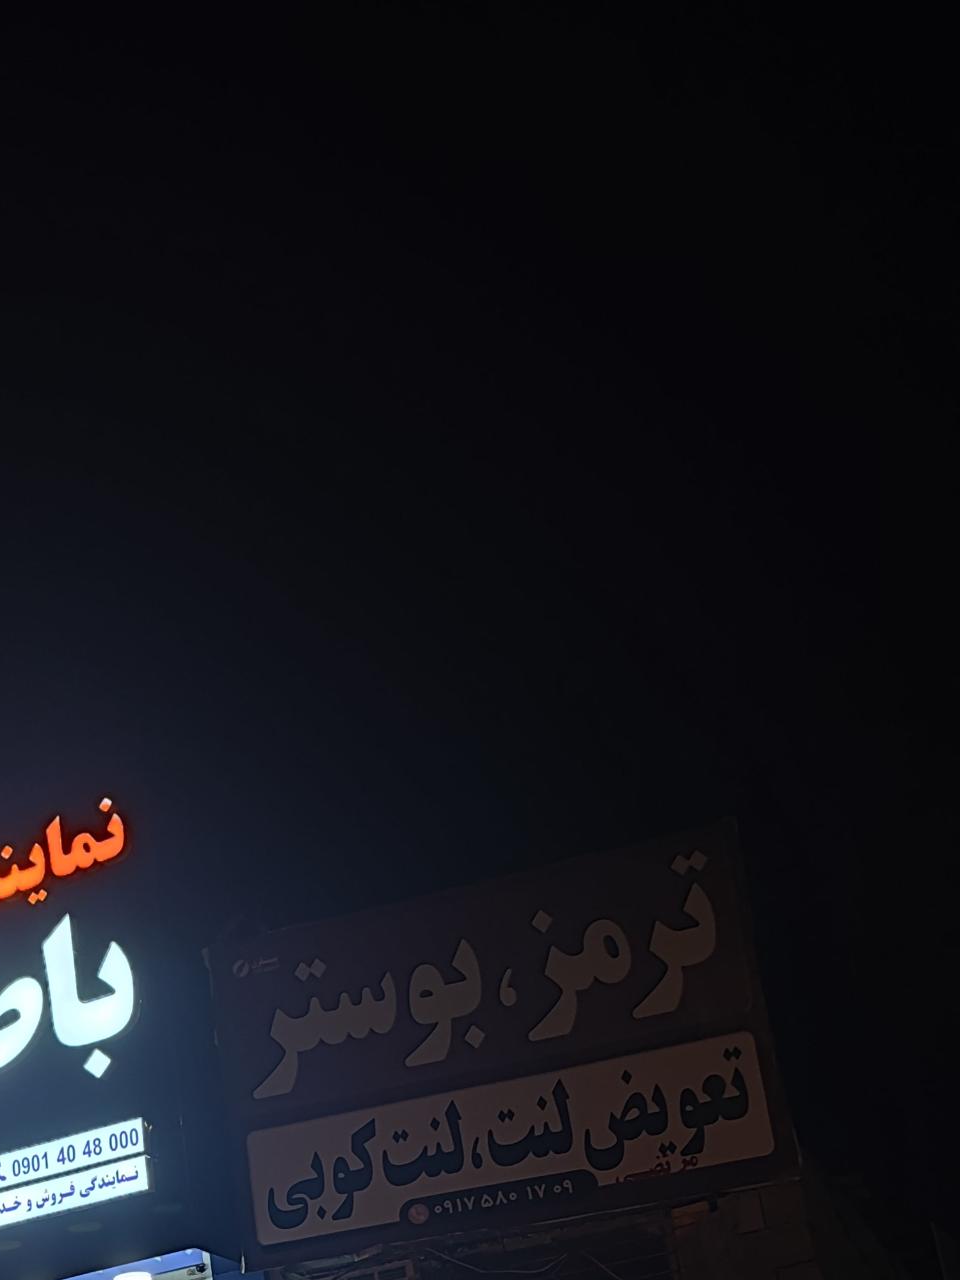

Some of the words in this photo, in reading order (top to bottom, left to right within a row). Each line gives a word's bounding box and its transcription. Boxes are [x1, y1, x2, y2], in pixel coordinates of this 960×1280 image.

[252, 938, 482, 1100] بوستر
[585, 1047, 750, 1172] تعویض
[12, 1151, 49, 1177] 0901
[57, 1144, 76, 1165] 40
[83, 1137, 102, 1158] 48
[109, 1127, 139, 1151] 000
[383, 1101, 464, 1187] لنت
[36, 1181, 76, 1209] فروش
[80, 1165, 139, 1198] نمایندگی
[268, 1119, 376, 1229] کوبی
[433, 1195, 475, 1216] ۰۹۱۷
[480, 1191, 518, 1209] ۵۸۰
[525, 1184, 546, 1201] ۱۷
[553, 1179, 574, 1195] ۰۹
[26, 1199, 32, 1211] و
